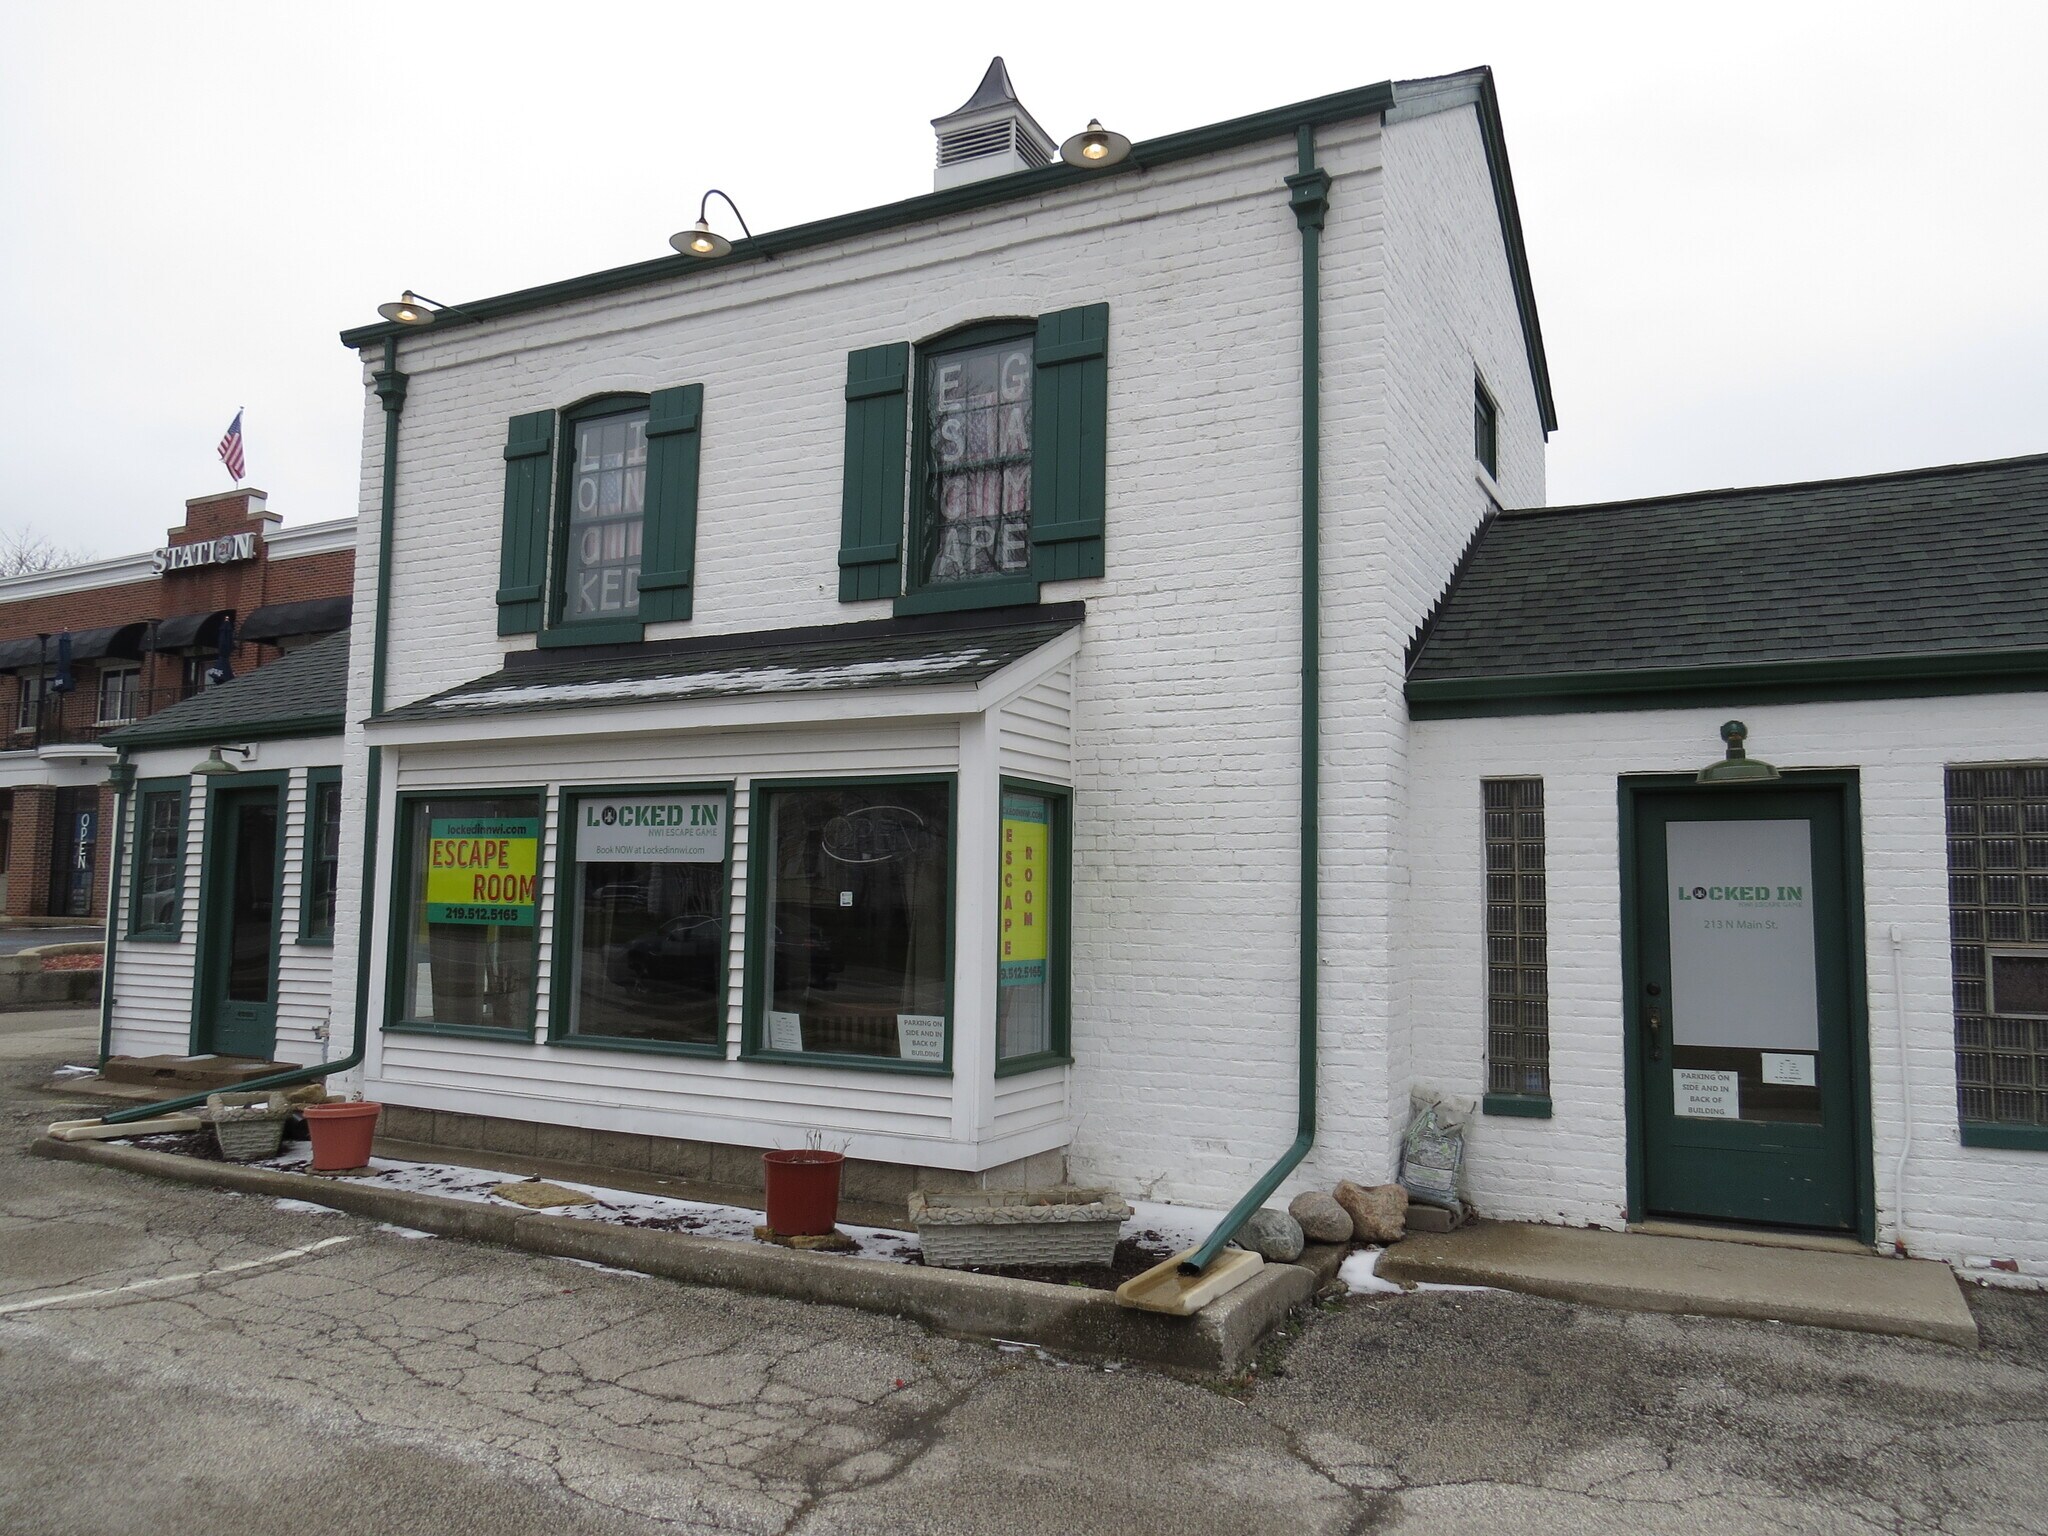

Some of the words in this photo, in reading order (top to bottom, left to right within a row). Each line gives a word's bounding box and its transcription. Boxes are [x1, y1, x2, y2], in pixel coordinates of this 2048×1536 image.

[587, 804, 684, 827] LOCKED
[690, 804, 719, 826] IN
[447, 824, 527, 835] lockedinnwi.com
[648, 829, 665, 837] NWI
[666, 829, 694, 837] ESCAPE
[695, 828, 718, 836] GAME
[77, 813, 90, 870] OPEN
[433, 840, 510, 868] ESCAPE
[596, 846, 613, 854] Book
[615, 846, 633, 854] NOW
[634, 846, 642, 854] at
[643, 846, 705, 855] Lockedinnwi.com
[473, 873, 537, 903] ROOM
[1004, 828, 1013, 956] ESCAPE
[1024, 846, 1033, 927] ROOM
[1678, 886, 1770, 901] LOCKED
[1777, 886, 1803, 901] IN
[445, 907, 519, 921] 219.512.5165
[1704, 920, 1722, 929] 213
[1726, 920, 1734, 929] N
[1736, 920, 1762, 929] Main
[1765, 920, 1778, 930] St.
[911, 1050, 940, 1058] BUILDING
[1681, 1072, 1716, 1081] PARKING
[1718, 1073, 1730, 1081] ON
[1690, 1095, 1710, 1103] BACK
[1712, 1096, 1723, 1104] OF
[1687, 1107, 1725, 1115] BUILDING
